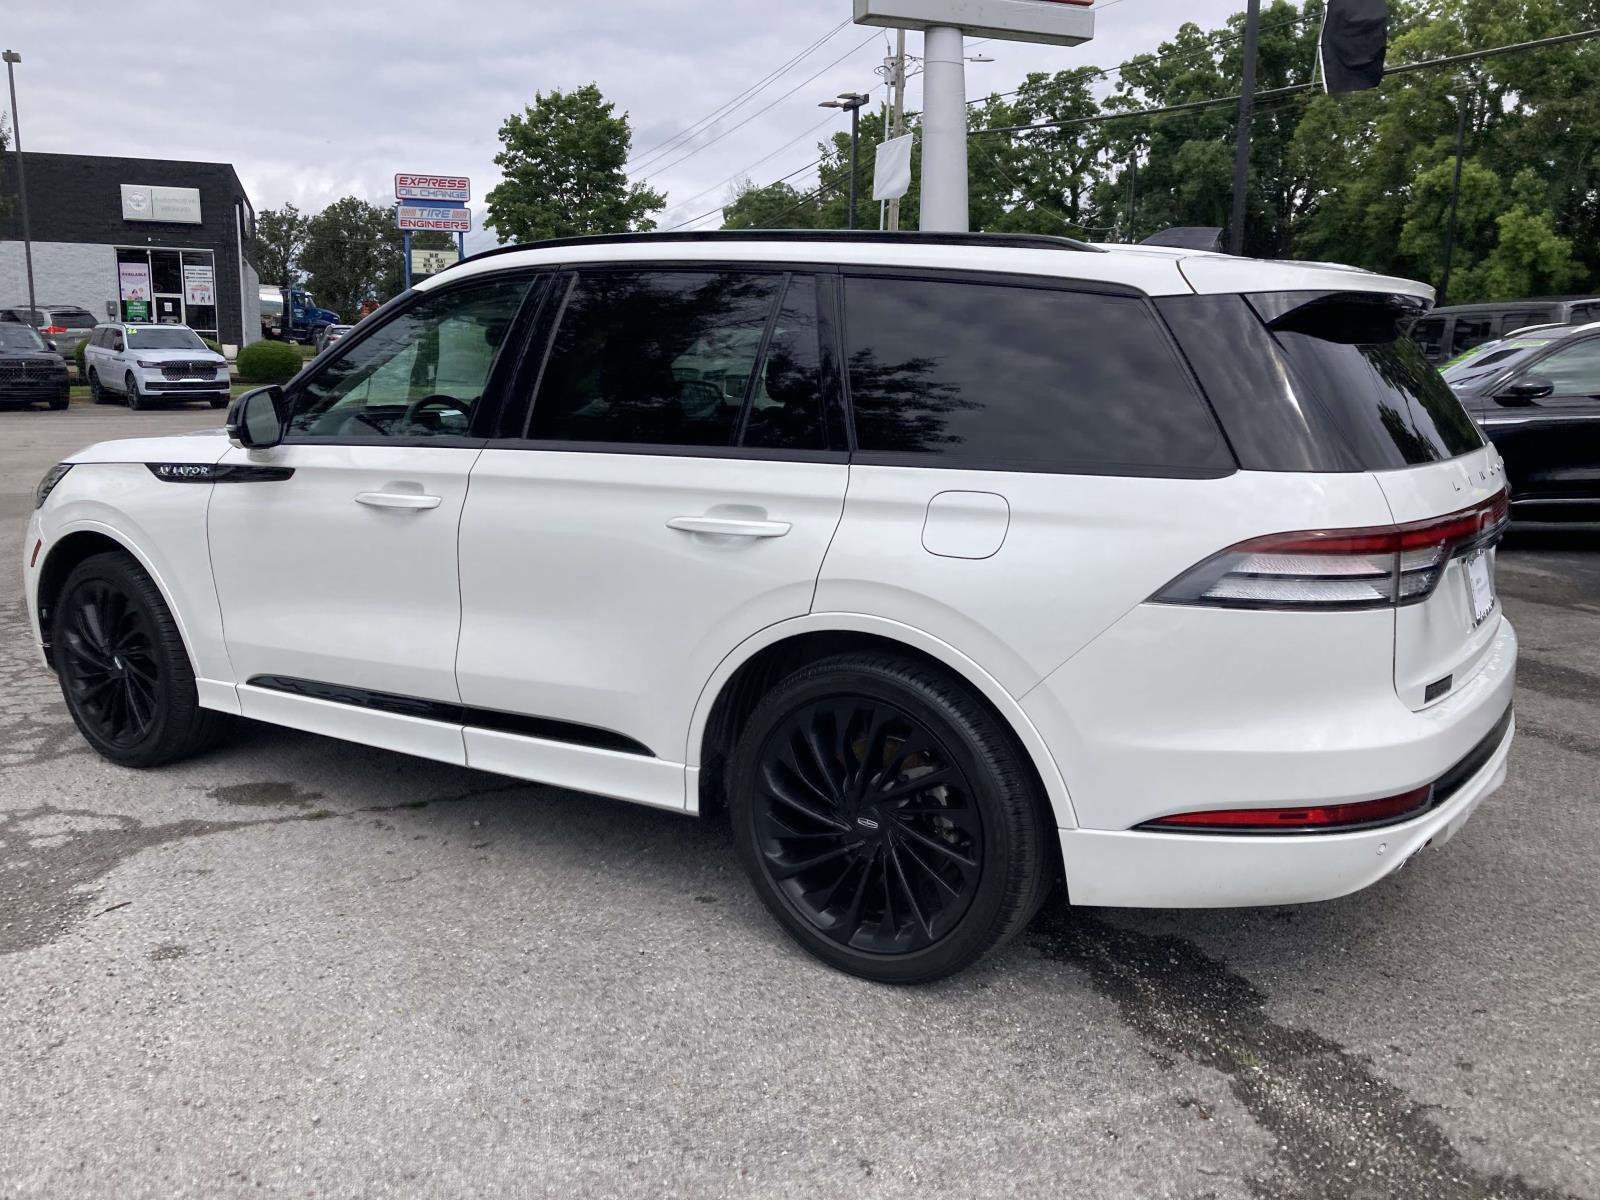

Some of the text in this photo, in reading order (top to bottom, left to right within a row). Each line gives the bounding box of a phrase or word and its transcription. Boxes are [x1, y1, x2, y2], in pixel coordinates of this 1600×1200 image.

[399, 177, 467, 188] EXPRESS
[399, 188, 467, 198] OIL CHANGE
[417, 208, 451, 218] TIRE
[400, 219, 468, 230] ENGINEERS
[158, 466, 209, 475] AVIATOR
